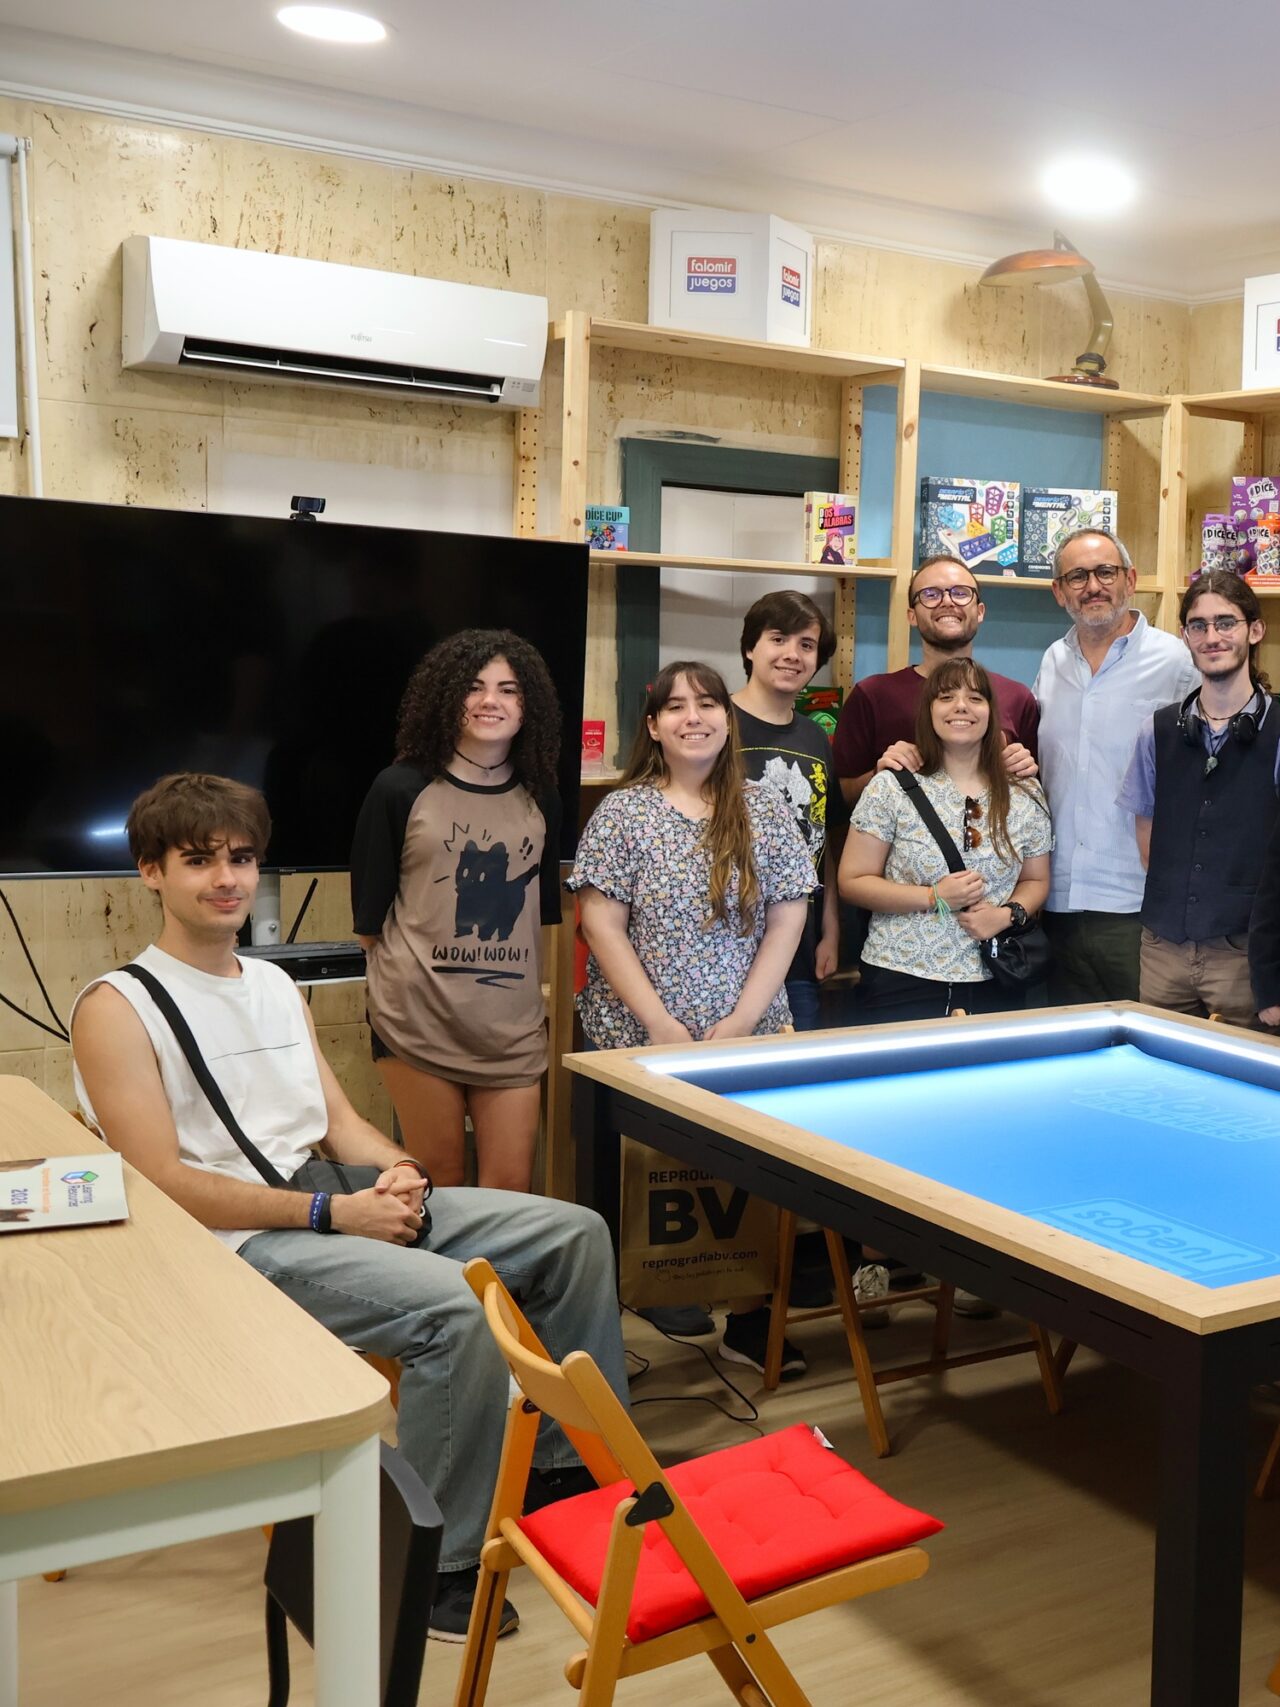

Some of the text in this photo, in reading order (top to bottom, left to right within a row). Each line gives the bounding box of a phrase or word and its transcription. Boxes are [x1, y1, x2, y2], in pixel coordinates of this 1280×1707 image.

[690, 258, 733, 273] falomir
[689, 277, 733, 291] juegos
[1254, 483, 1274, 495] DICE
[605, 511, 623, 521] CUP
[820, 508, 833, 518] DOS
[820, 515, 852, 528] PALABRAS
[1206, 529, 1226, 539] DICE
[649, 1186, 749, 1246] BV
[1073, 1208, 1250, 1264] juegos
[642, 1250, 758, 1270] reprografiabv.com
